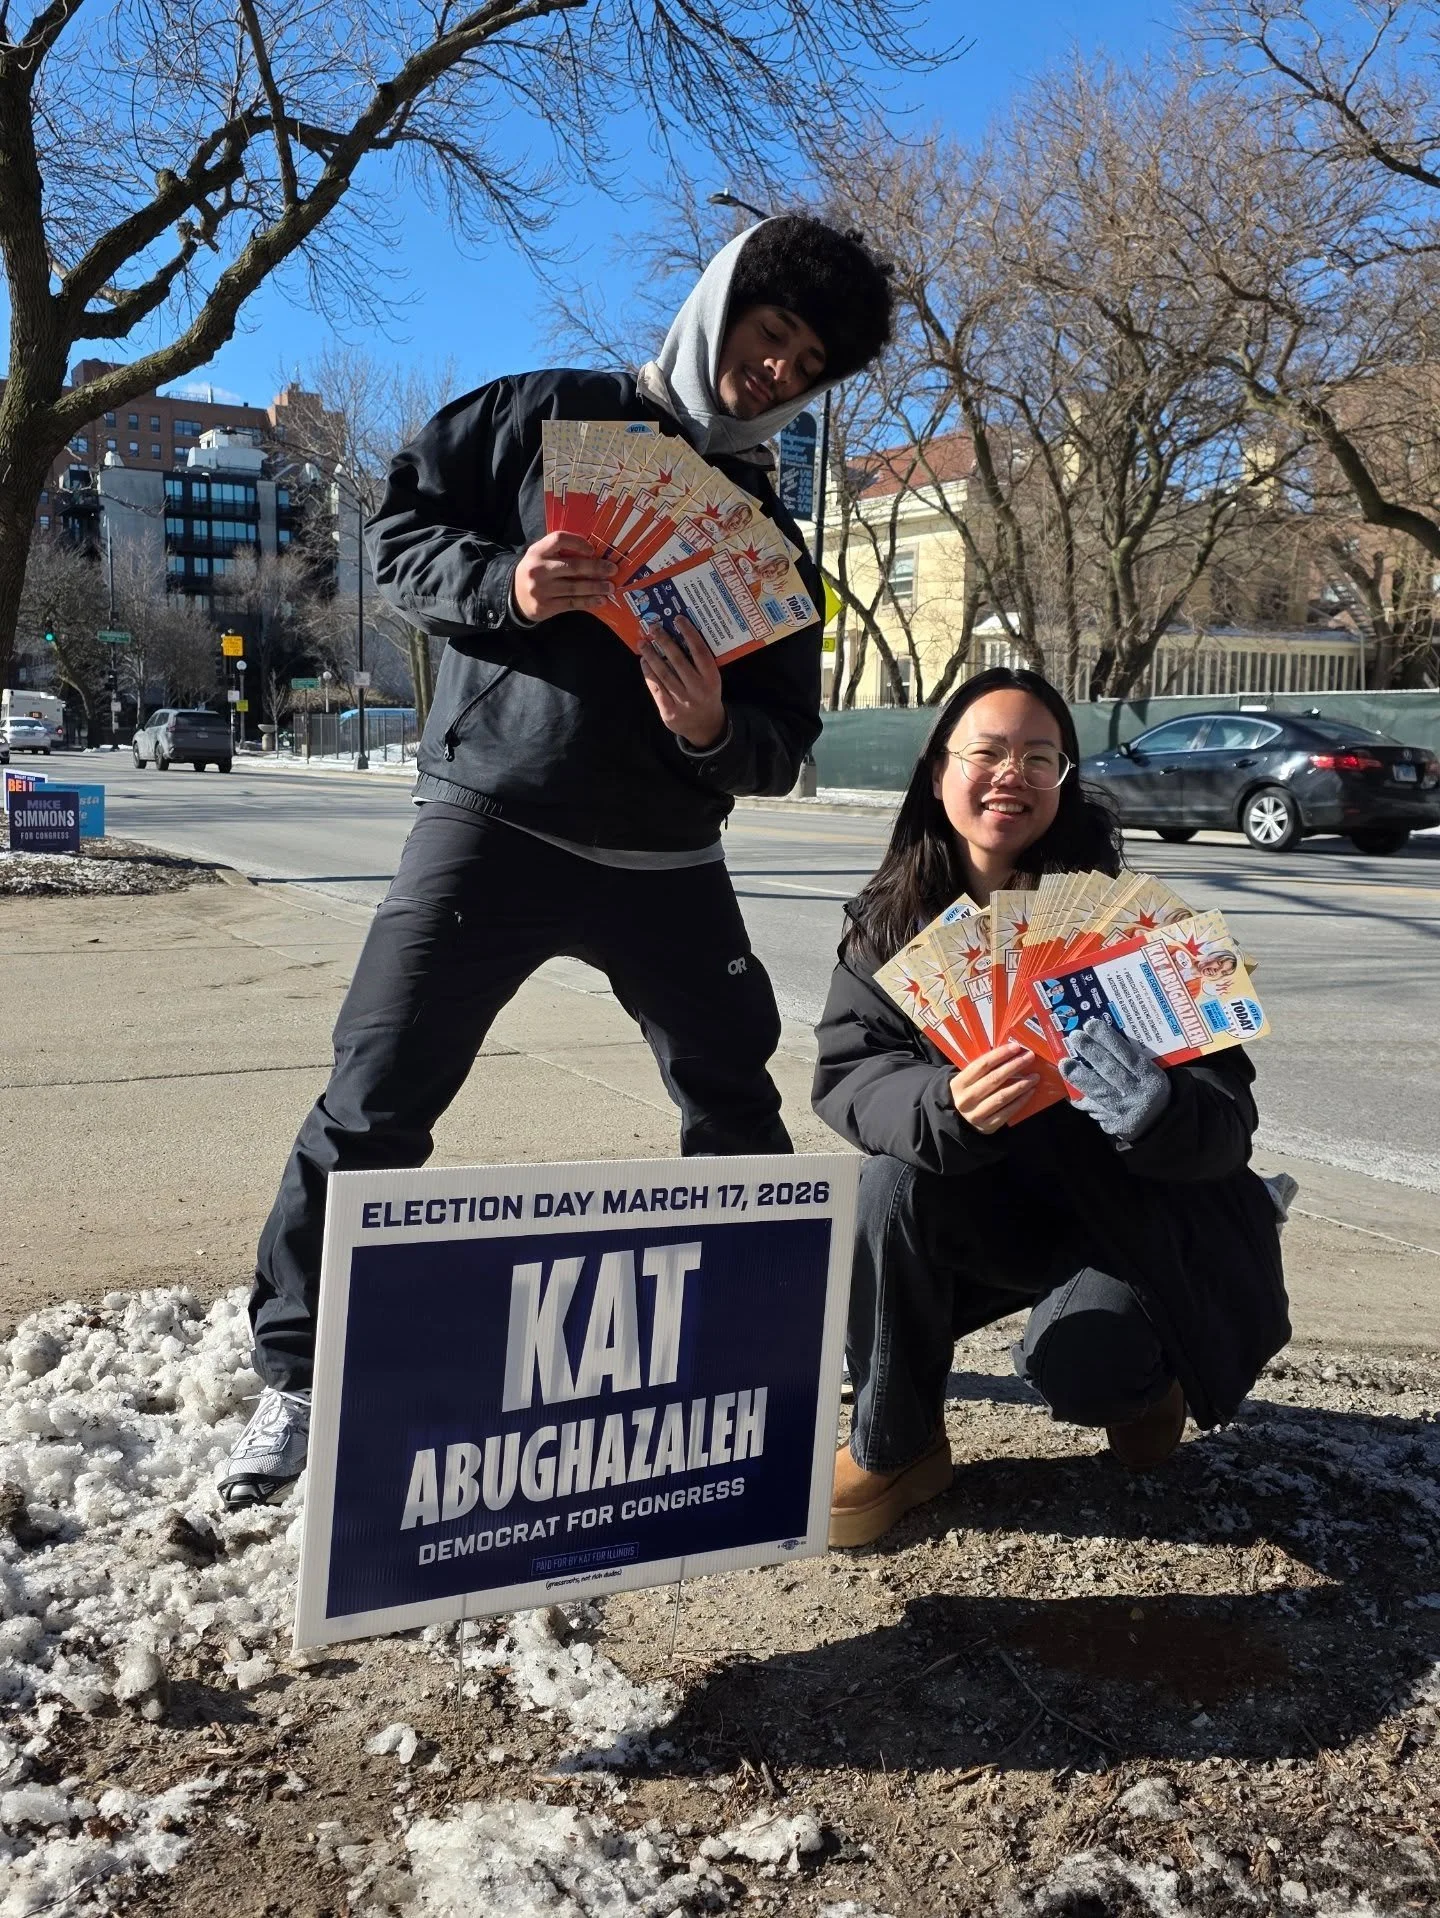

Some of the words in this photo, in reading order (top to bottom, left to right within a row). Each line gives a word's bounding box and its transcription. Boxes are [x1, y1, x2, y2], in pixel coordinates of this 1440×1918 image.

[630, 425, 646, 433] VOTE
[676, 520, 701, 544] KAT
[710, 572, 720, 584] FOR
[713, 553, 733, 575] KAT
[723, 572, 769, 638] ABUGHAZALEH
[801, 597, 812, 611] VOTE
[786, 596, 808, 621] TODAY
[27, 800, 61, 809] MIKE
[14, 810, 75, 827] SIMMONS
[21, 832, 33, 840] FOR
[36, 831, 69, 840] CONGRESS
[945, 907, 960, 922] VOTE
[728, 957, 747, 975] OR
[1144, 942, 1171, 969] KAT
[1141, 963, 1152, 978] FOR
[1148, 977, 1170, 1014] CONGRESS
[1156, 967, 1209, 1046] ABUGHAZALEH
[1231, 1000, 1255, 1031] TODAY
[1249, 1004, 1260, 1021] VOTE
[362, 1194, 523, 1228] ELECTION
[534, 1191, 595, 1218] DAY
[602, 1186, 709, 1214] MARCH
[717, 1184, 748, 1211] 17,
[757, 1181, 830, 1206] 2026
[501, 1242, 702, 1412] KAT
[400, 1387, 768, 1530] ABUGHAZALEH
[418, 1517, 556, 1566] DEMOCRAT
[566, 1505, 613, 1532] FOR
[621, 1477, 745, 1521] CONGRESS
[536, 1559, 552, 1571] PAID
[553, 1557, 567, 1569] FOR
[568, 1555, 577, 1566] BY
[579, 1554, 591, 1564] KAT
[592, 1551, 606, 1562] FOR
[606, 1546, 635, 1560] ILLINOIS
[546, 1576, 580, 1590] (grassroots,
[592, 1572, 602, 1580] rich
[604, 1568, 622, 1578] dudes)
